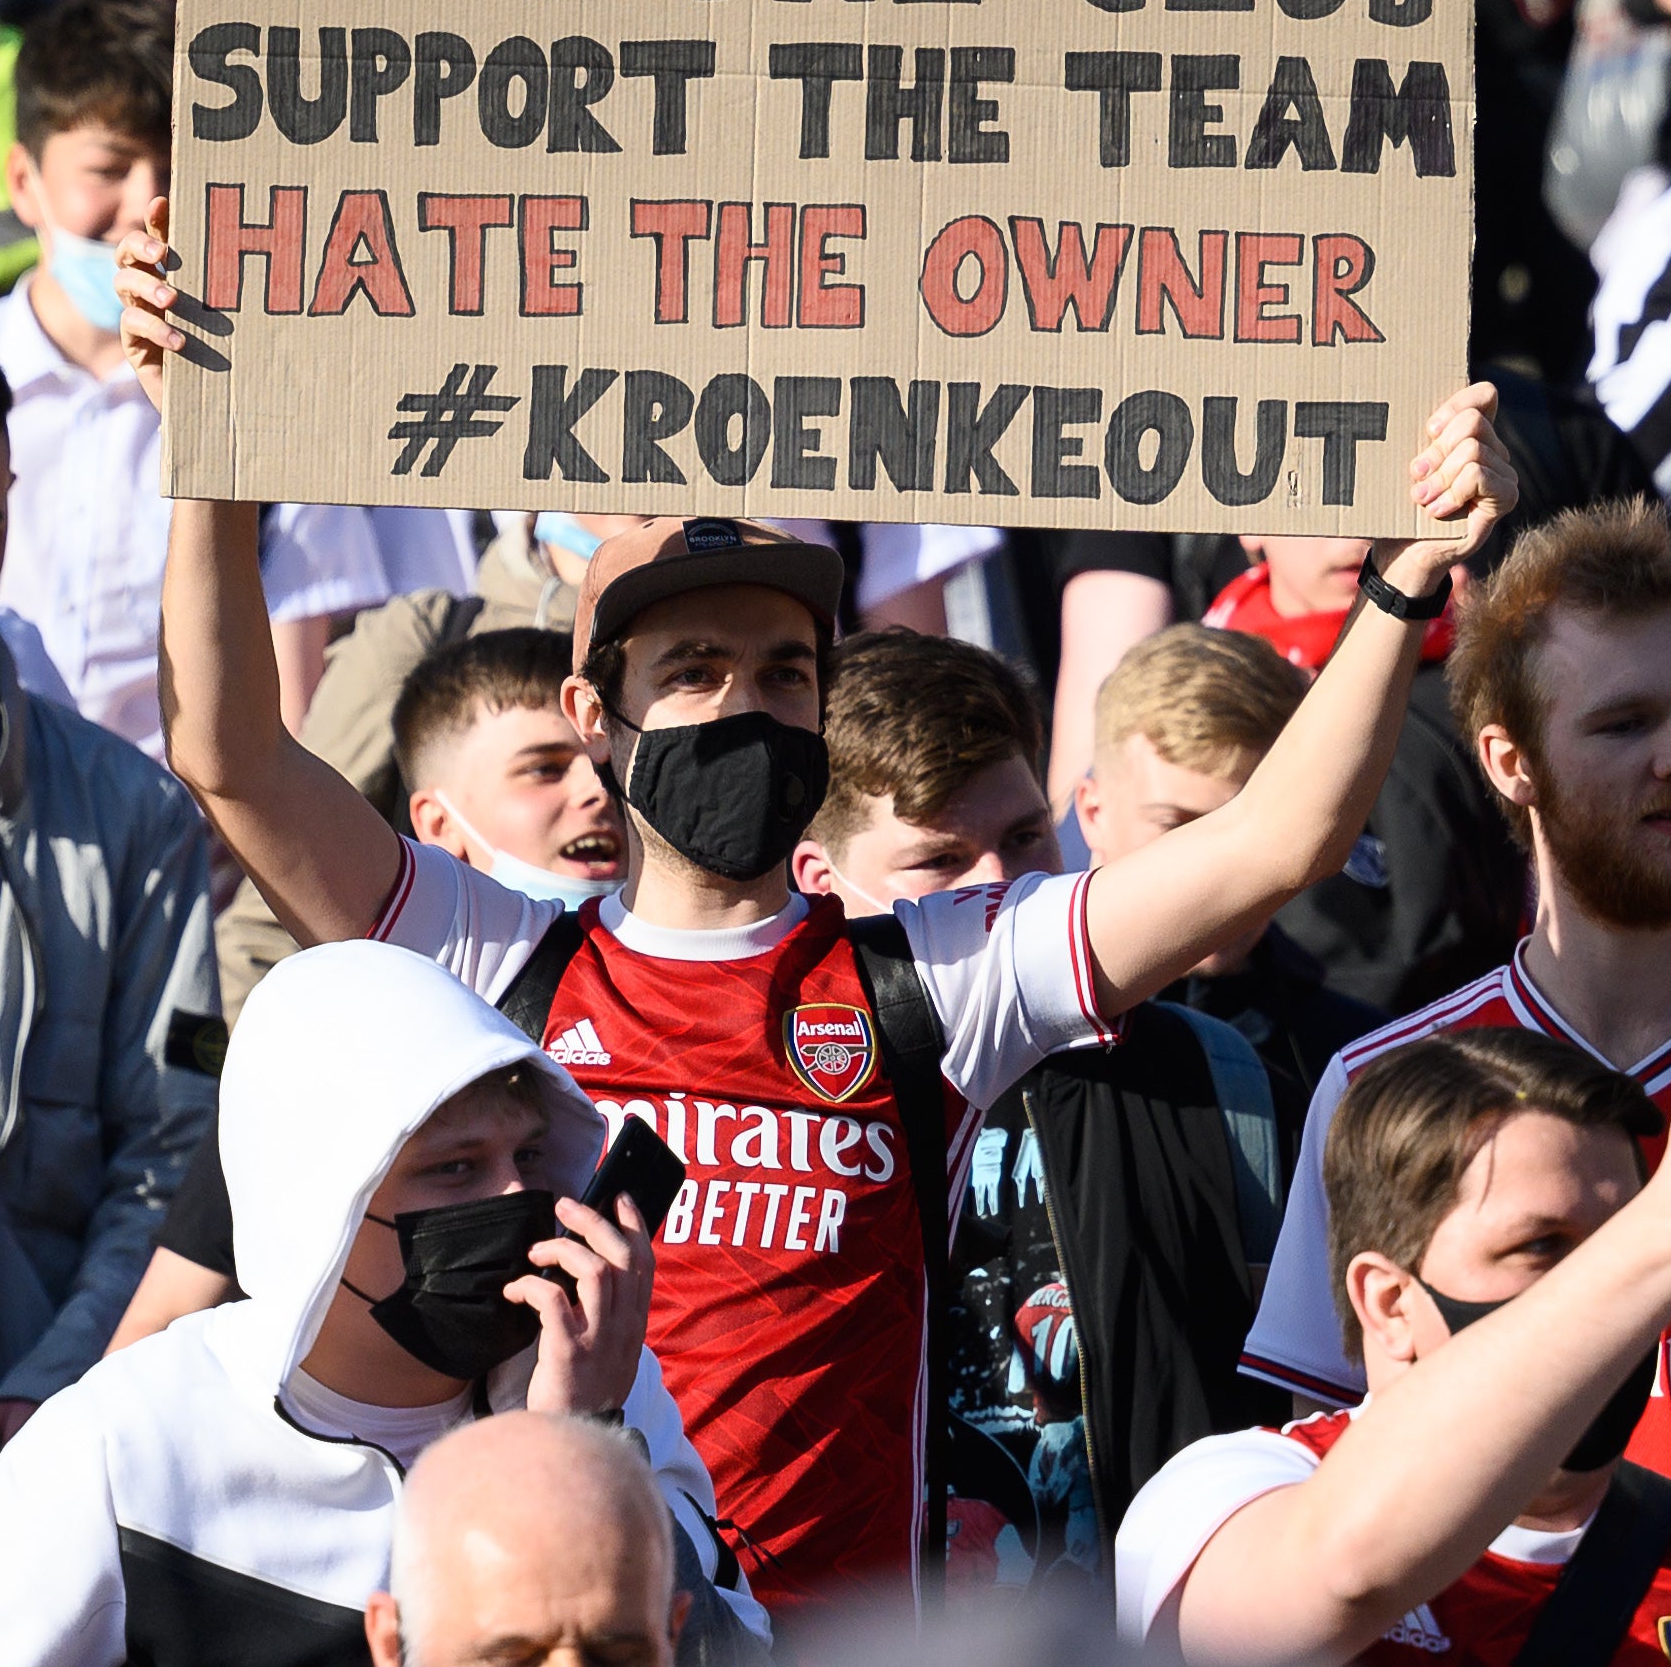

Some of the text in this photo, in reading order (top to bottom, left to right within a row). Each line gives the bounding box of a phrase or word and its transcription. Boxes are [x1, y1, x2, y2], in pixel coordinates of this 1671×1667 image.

[188, 22, 1456, 178] SUPPORT THE TEAM
[203, 182, 1385, 347] HATE THE OWNER
[387, 364, 1388, 506] #KROENKEOUT
[798, 1021, 861, 1037] Arsenal
[596, 1092, 895, 1182] mirates
[663, 1179, 847, 1253] BETTER
